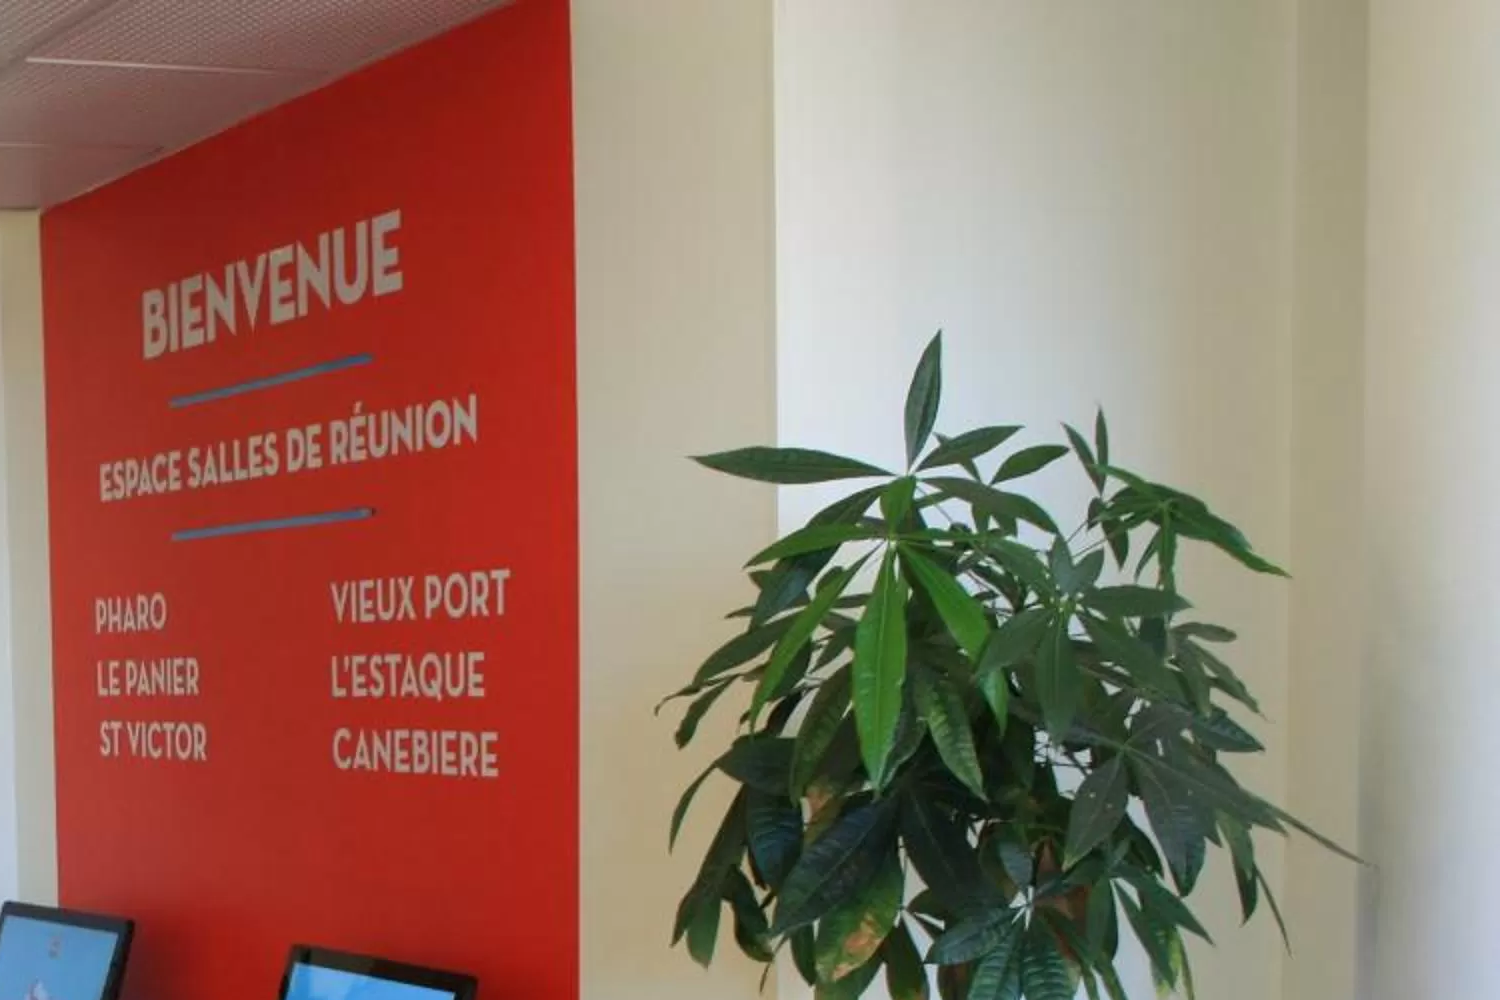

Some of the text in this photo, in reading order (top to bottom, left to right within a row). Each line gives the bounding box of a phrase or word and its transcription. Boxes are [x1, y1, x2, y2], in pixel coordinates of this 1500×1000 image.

[143, 210, 403, 360] BIENVENUE
[99, 393, 477, 502] ESPACE SALLES DE RÉUNION
[94, 592, 167, 635] PHARO
[331, 568, 511, 623] VIEUX PORT
[96, 657, 200, 697] LE PANIER
[331, 651, 485, 702] L'ESTAQUE
[99, 719, 207, 761] ST VICTOR
[332, 727, 499, 778] CANEBIERE
